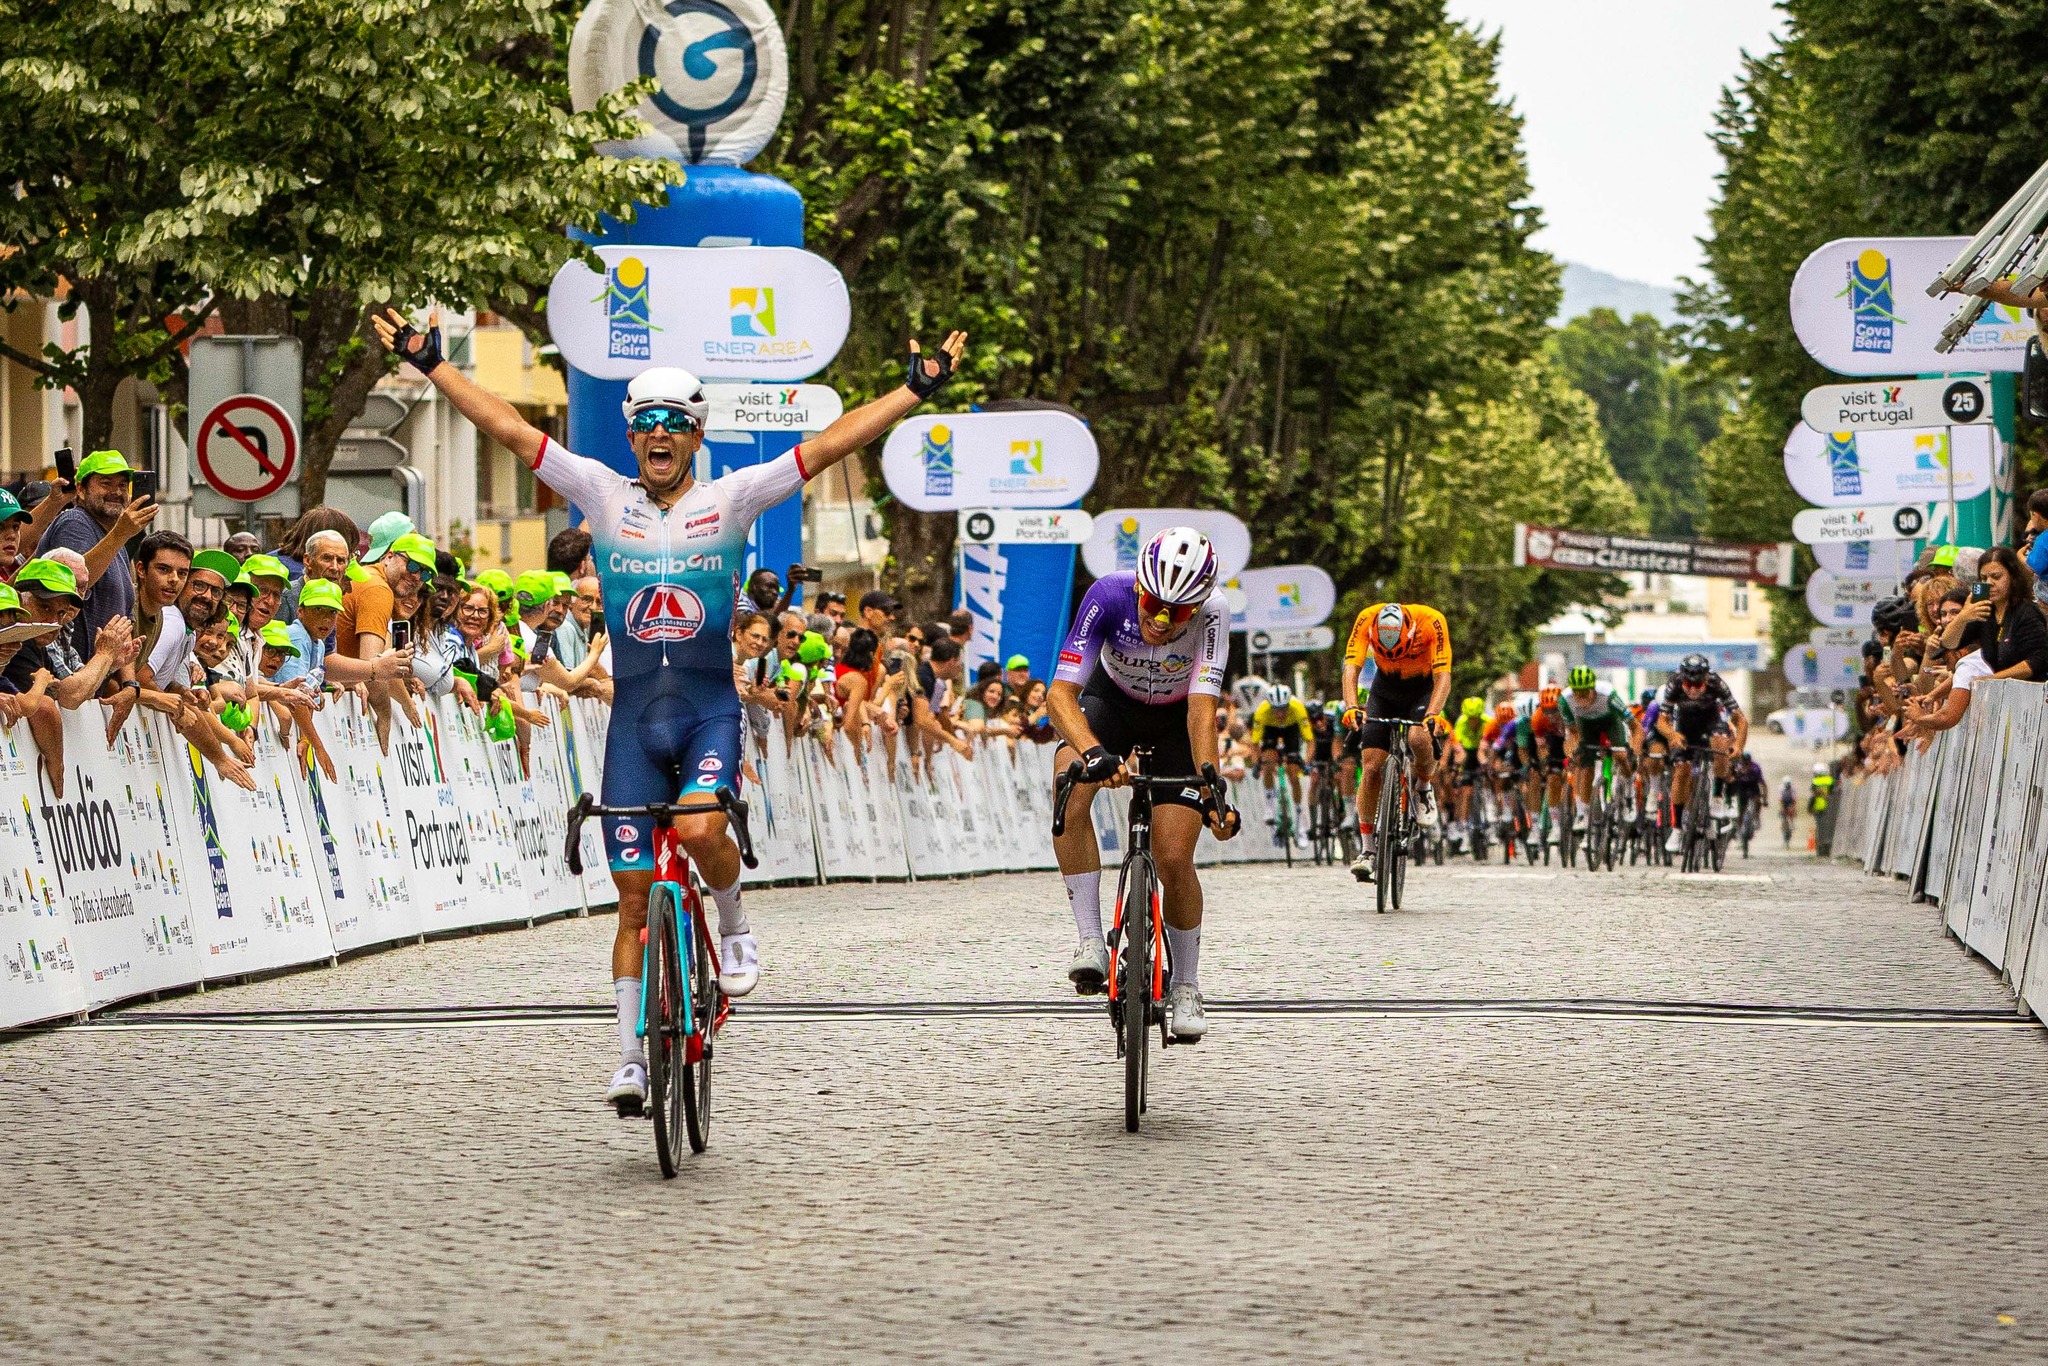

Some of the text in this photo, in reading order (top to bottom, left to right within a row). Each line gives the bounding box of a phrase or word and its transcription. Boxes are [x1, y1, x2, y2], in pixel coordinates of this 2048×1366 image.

[1855, 322, 1891, 337] Cova
[611, 330, 648, 344] Cova
[1855, 335, 1891, 349] Beira
[610, 343, 650, 356] Beira
[738, 391, 774, 405] visit
[1841, 391, 1876, 405] visit
[1951, 392, 1975, 412] 25
[735, 409, 809, 426] Portugal
[1839, 407, 1913, 425] Portugal
[1018, 516, 1043, 527] visit
[1821, 514, 1847, 525] visit
[1016, 528, 1069, 541] Portugal
[1820, 526, 1873, 538] Portugal
[1080, 605, 1099, 637] CORTIZO
[1206, 627, 1216, 660] CORTIZO
[395, 724, 431, 787] visit
[37, 753, 122, 898] fundão
[1131, 824, 1149, 833] BH
[405, 806, 471, 885] Portugal
[69, 894, 85, 925] 365
